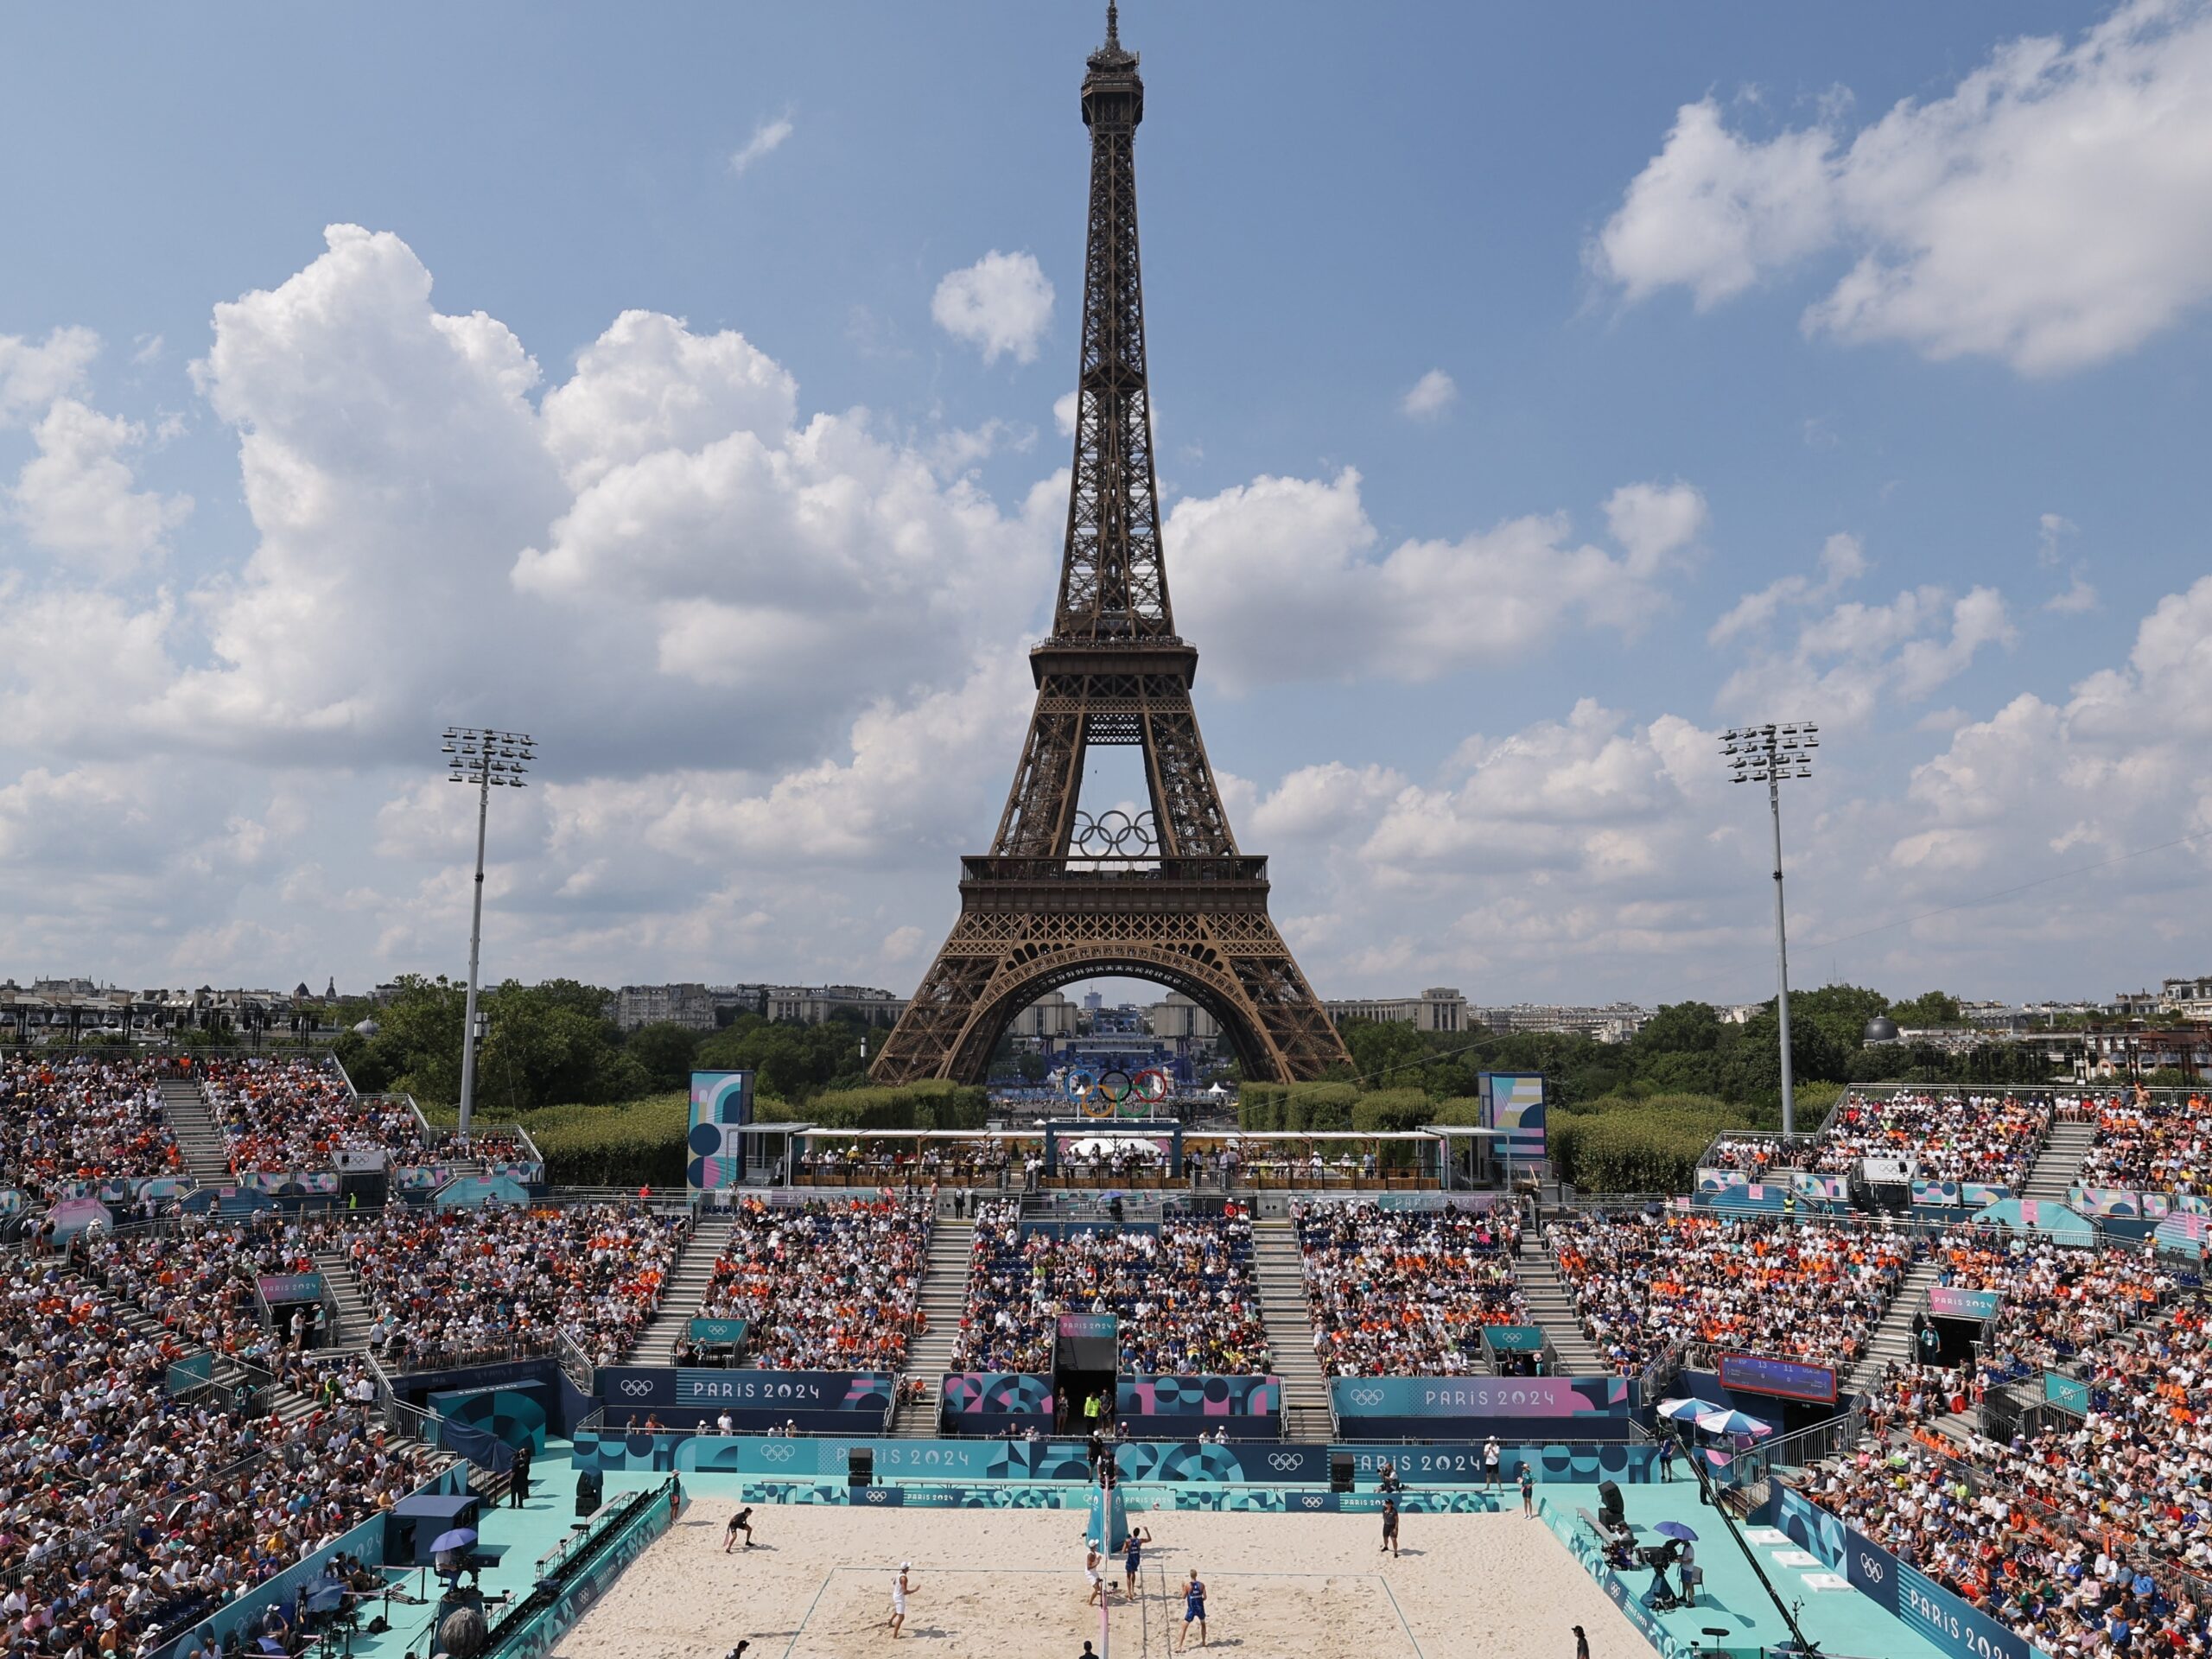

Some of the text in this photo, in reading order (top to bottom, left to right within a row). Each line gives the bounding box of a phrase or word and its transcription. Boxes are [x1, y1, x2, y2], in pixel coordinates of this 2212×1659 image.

[1935, 1296, 1992, 1308] PARIS 2024
[764, 1383, 819, 1399] 2024
[1497, 1391, 1554, 1405] 2024
[911, 1450, 968, 1465] 2024
[1421, 1456, 1480, 1471] 2024
